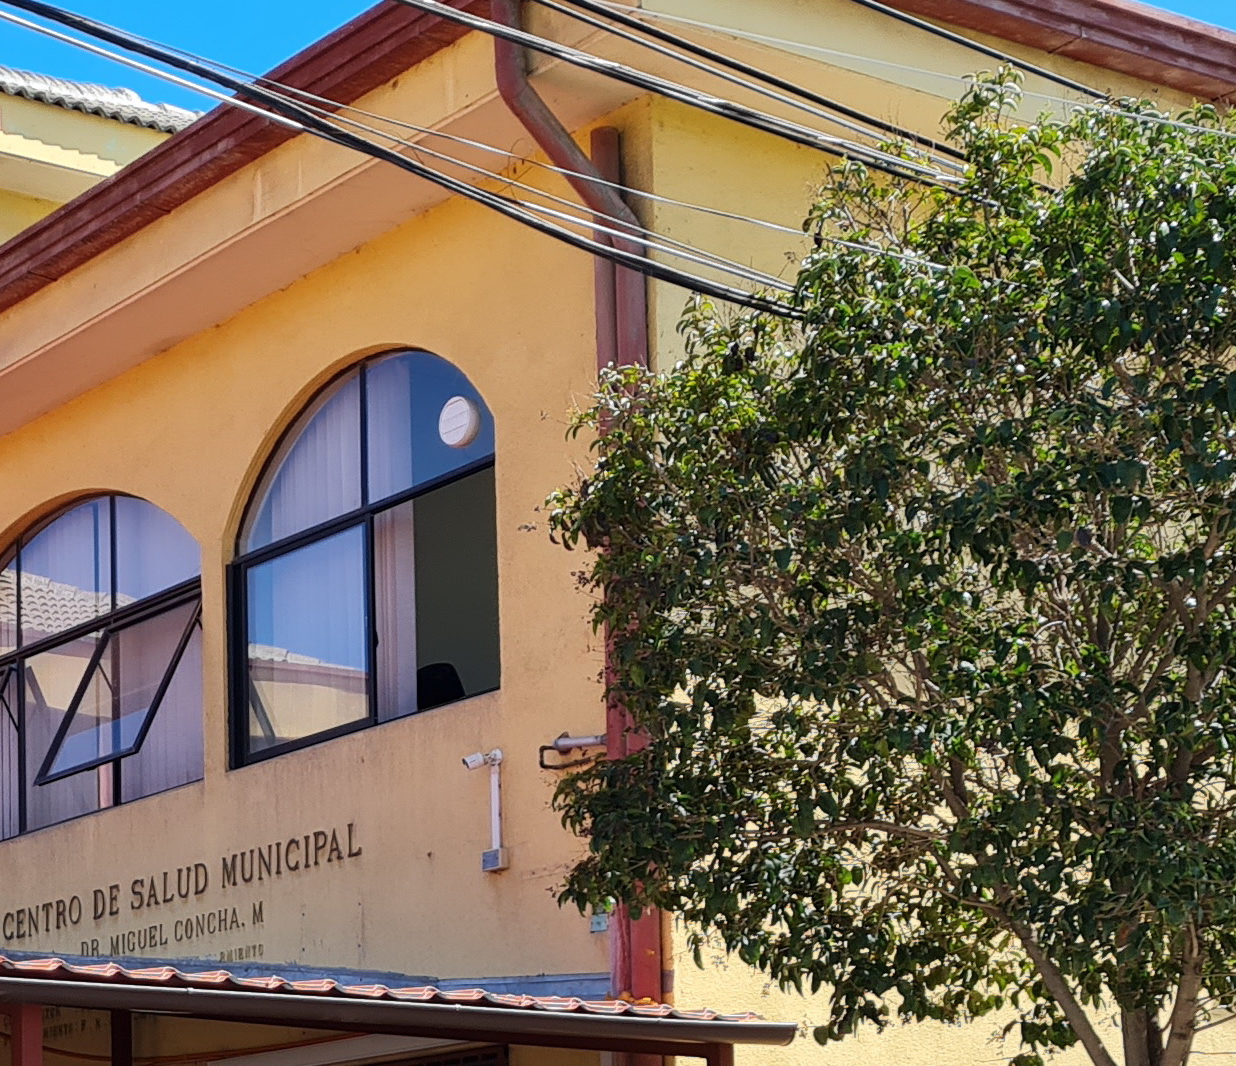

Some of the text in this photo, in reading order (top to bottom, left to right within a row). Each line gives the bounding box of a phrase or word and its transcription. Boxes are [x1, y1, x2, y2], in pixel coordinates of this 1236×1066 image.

[2, 822, 363, 942] CENTRO DE SALUD MUNICIPAL
[110, 923, 169, 957] MIGUEL
